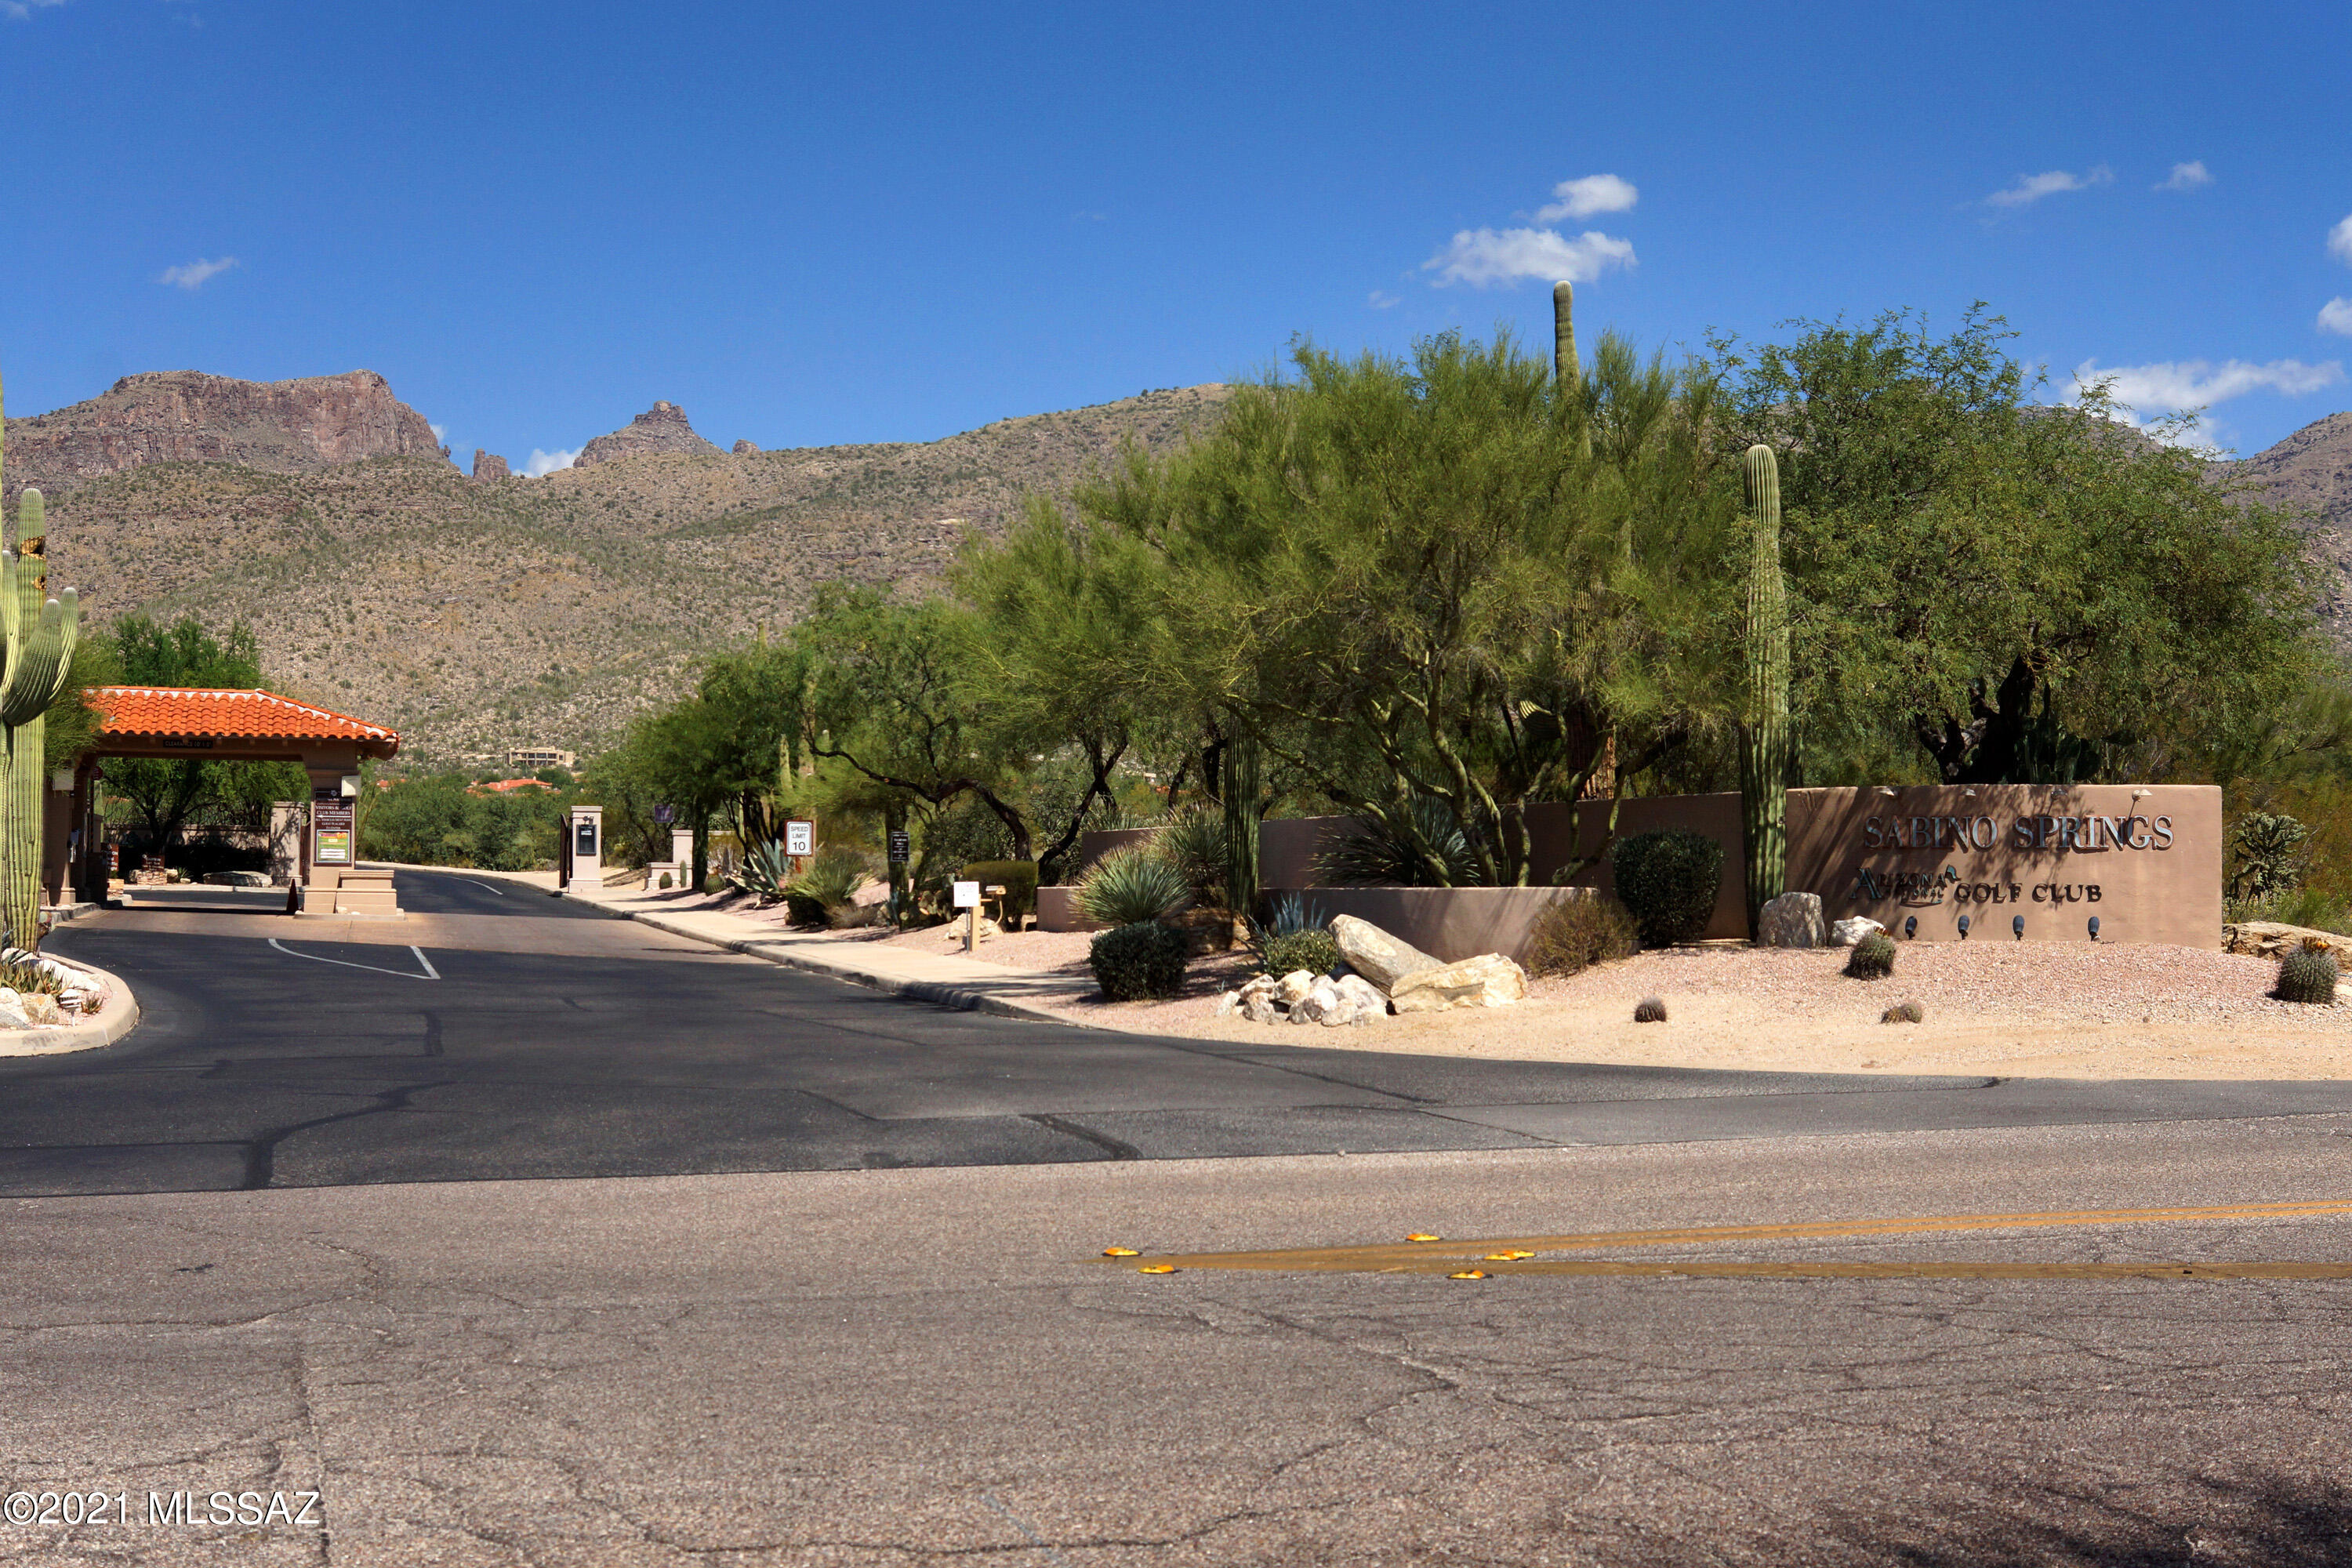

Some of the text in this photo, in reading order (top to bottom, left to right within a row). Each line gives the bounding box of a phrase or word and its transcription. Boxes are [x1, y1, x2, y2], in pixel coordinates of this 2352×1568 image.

[793, 841, 806, 851] 10
[1864, 815, 2174, 851] SABINO SPRINGS
[1850, 867, 1947, 899] ARIZONA
[1954, 882, 2102, 903] GOLF CLUB
